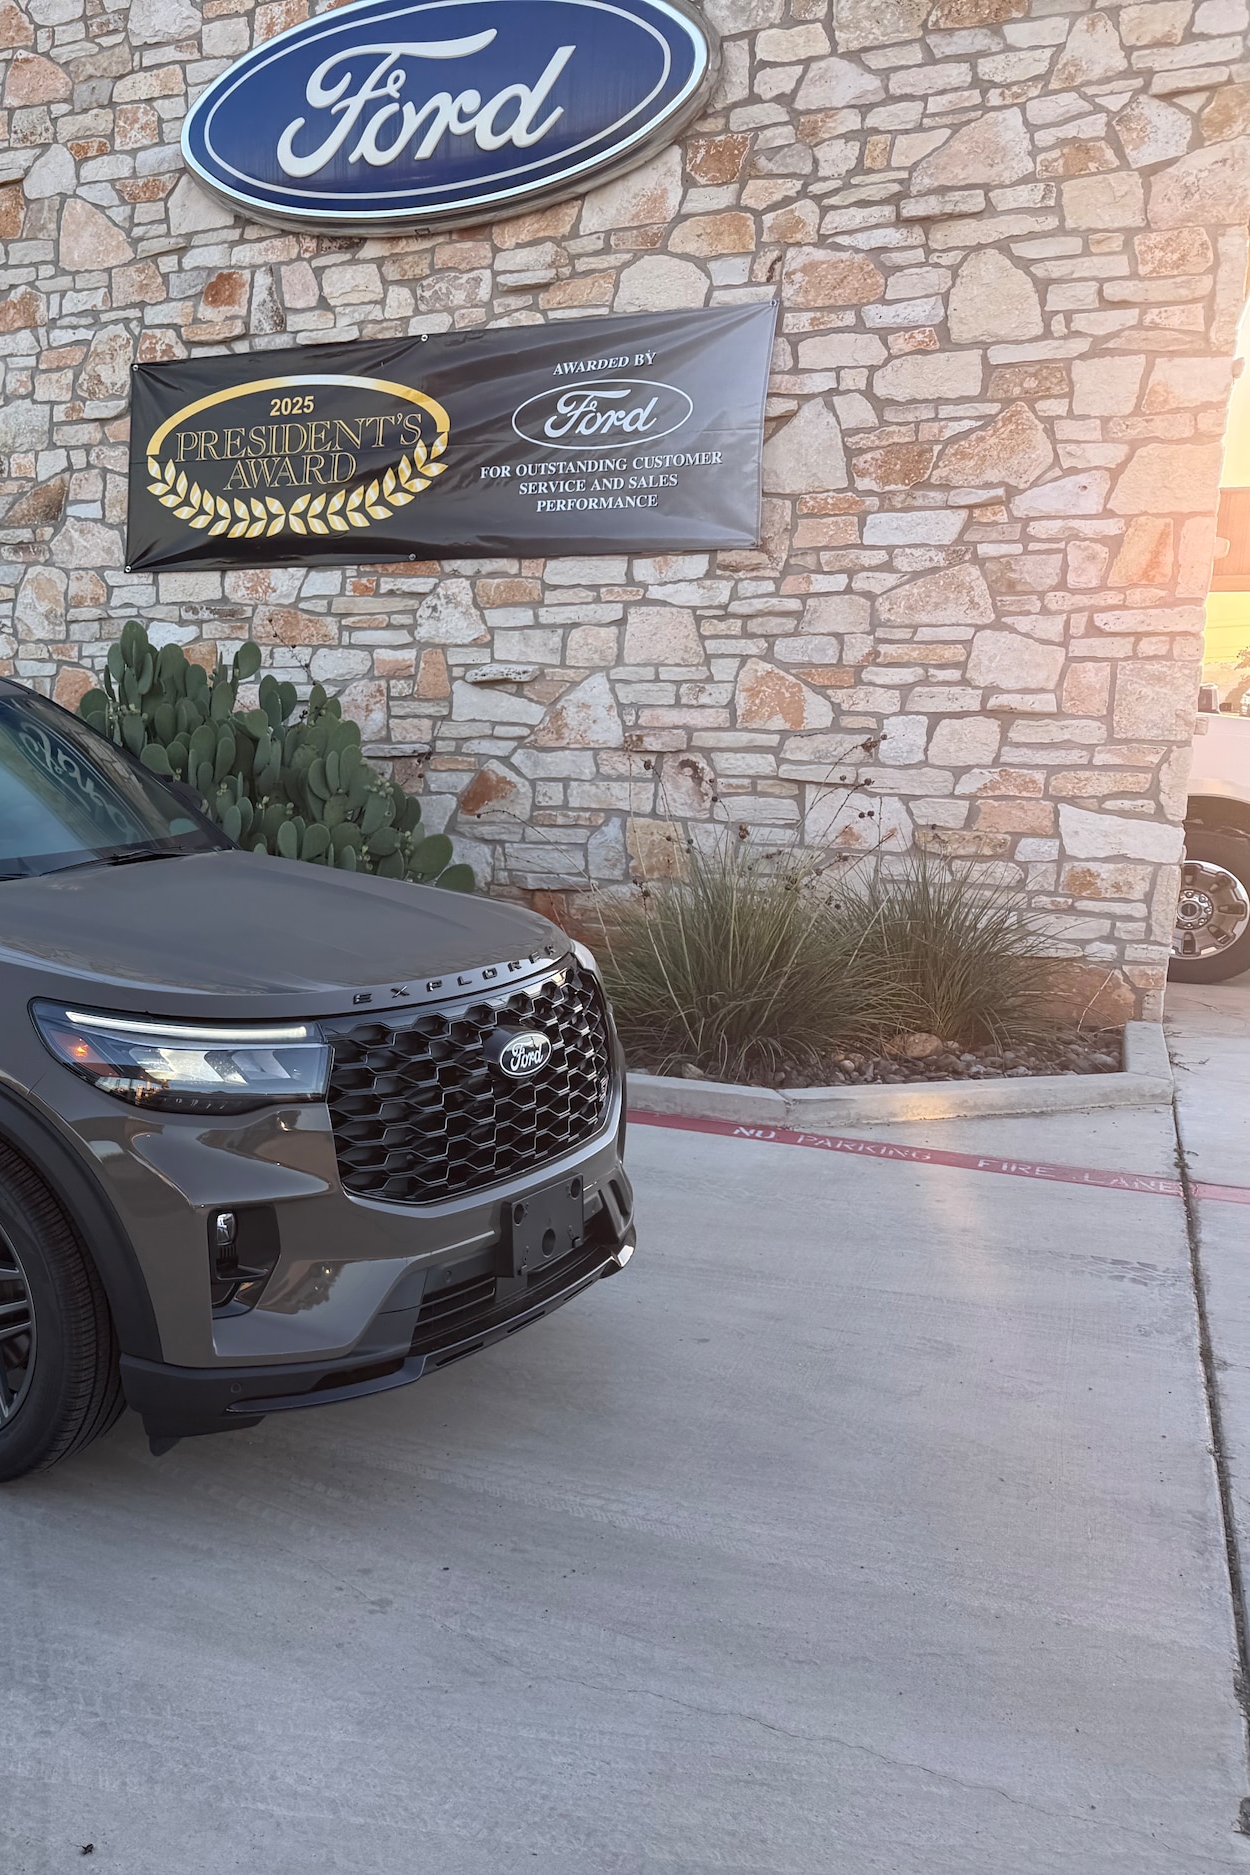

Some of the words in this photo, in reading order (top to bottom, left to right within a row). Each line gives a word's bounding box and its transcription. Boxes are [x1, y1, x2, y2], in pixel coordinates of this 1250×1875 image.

[276, 28, 577, 178] Ford
[553, 357, 629, 376] AWARDED
[634, 352, 657, 366] BY
[269, 396, 315, 416] 2025
[544, 389, 659, 438] Ford
[175, 413, 422, 462] PRESIDENT'S
[223, 452, 357, 490] AWARD
[480, 465, 511, 479] FOR
[515, 457, 628, 477] OUTSTANDING
[632, 451, 723, 469] CUSTOMER
[519, 479, 586, 495] SERVICE
[590, 478, 625, 491] AND
[628, 474, 678, 488] SALES
[536, 494, 659, 513] PERFORMANCE
[352, 944, 556, 1005] EXPLORER
[509, 1040, 543, 1072] Ford
[733, 1126, 775, 1139] NO
[796, 1134, 932, 1161] PARKING
[977, 1158, 1056, 1178] FIRE
